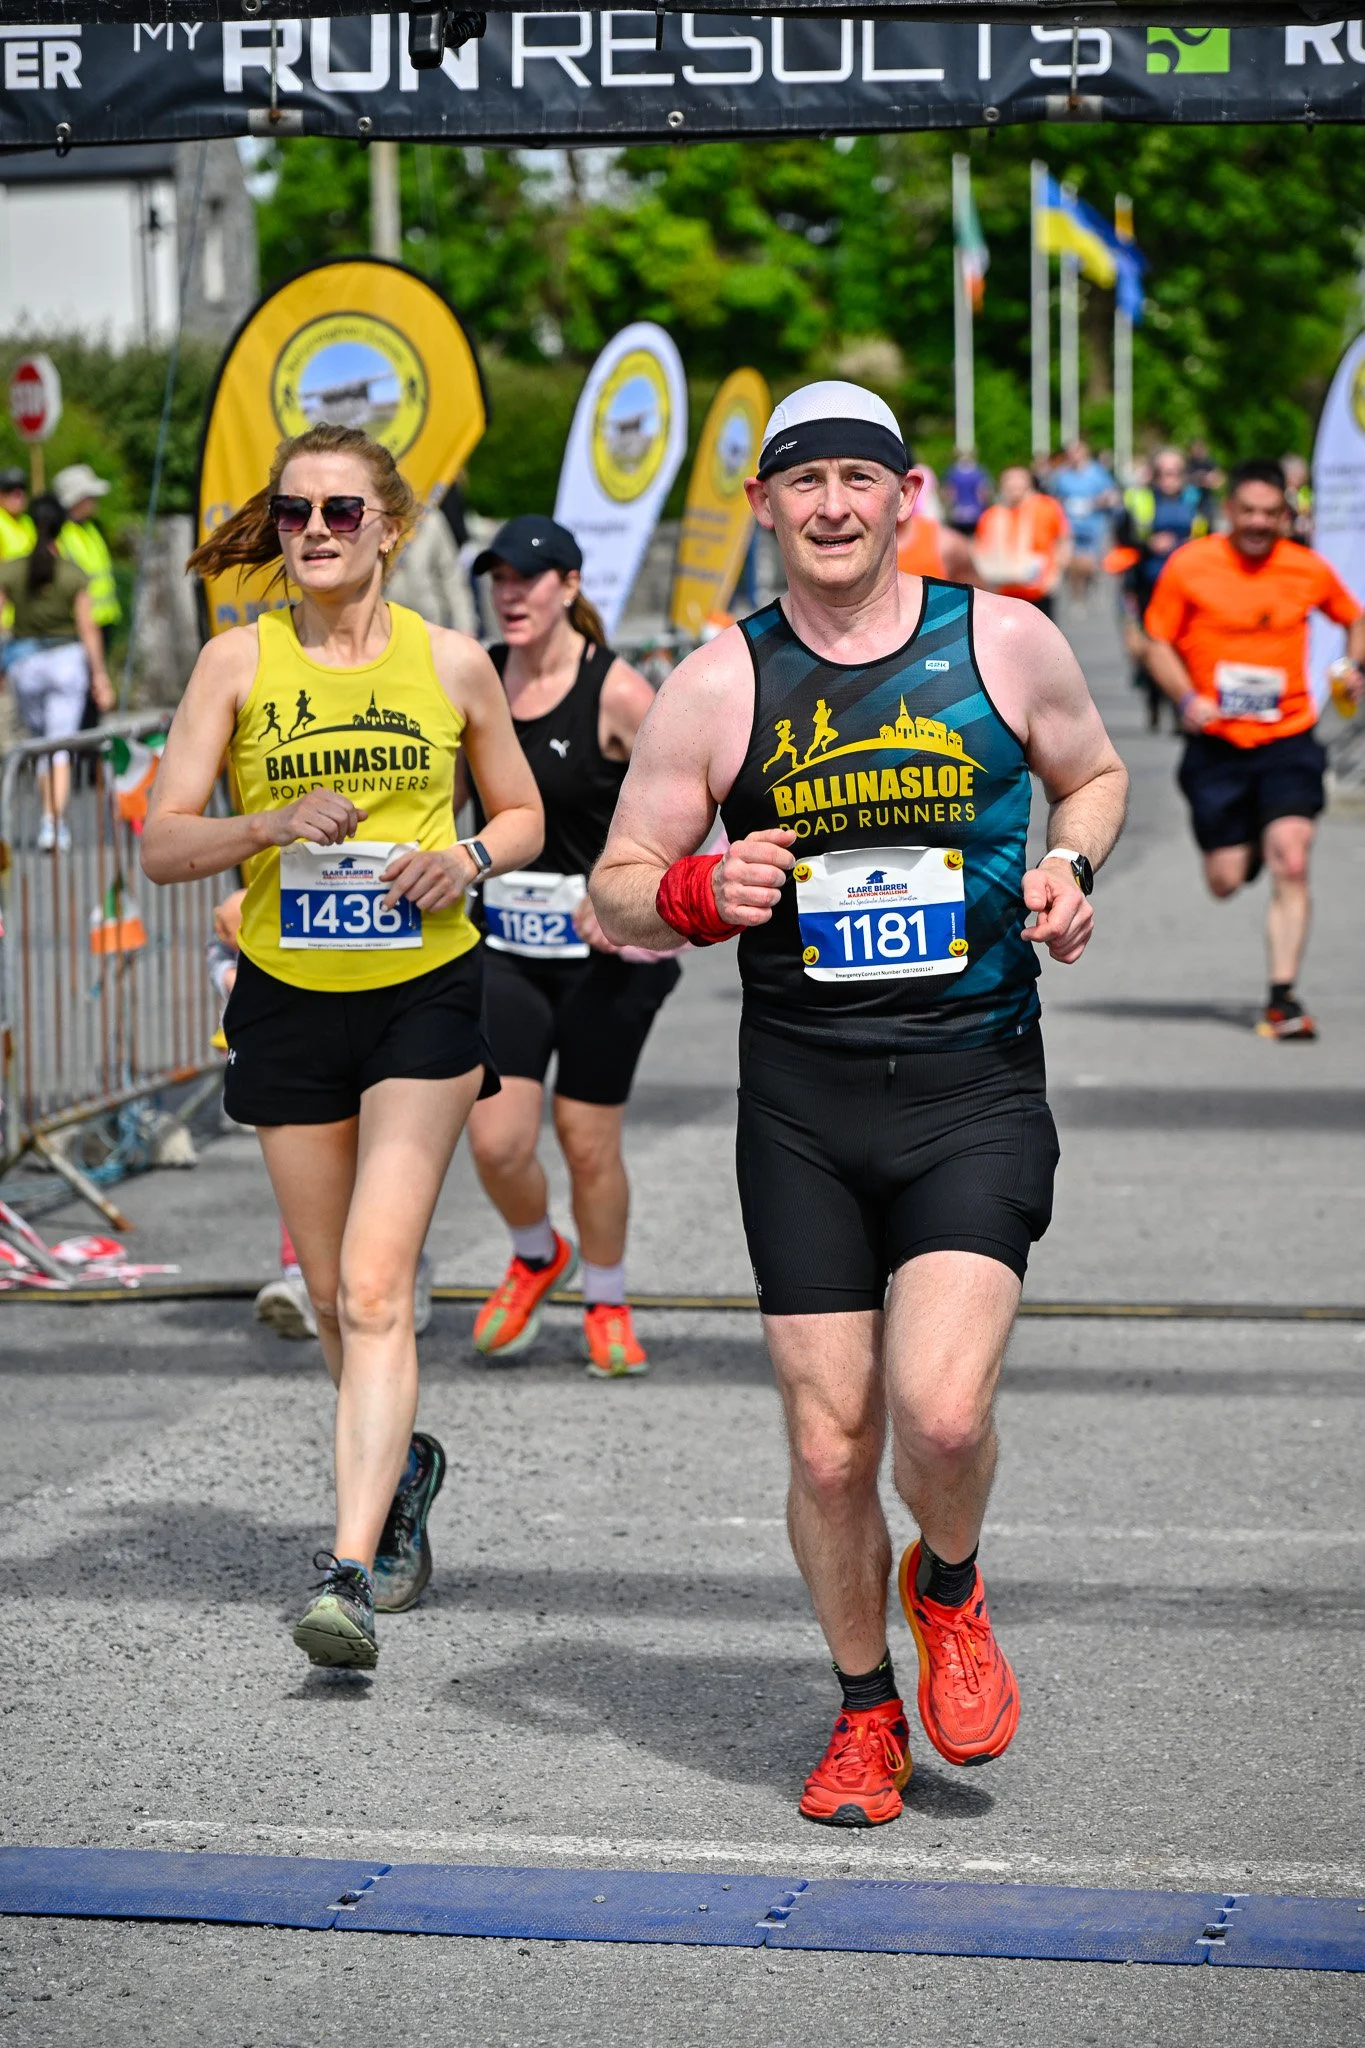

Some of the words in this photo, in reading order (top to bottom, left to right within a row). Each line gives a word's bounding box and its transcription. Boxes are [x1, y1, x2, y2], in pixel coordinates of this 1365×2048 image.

[133, 22, 204, 53] MY
[222, 12, 479, 93] RUN
[266, 745, 431, 781] BALLINASLOE
[333, 776, 430, 793] RUNNERS
[772, 765, 974, 818] BALLINASLOE
[858, 803, 976, 828] RUNNERS
[874, 883, 908, 892] BURREN
[296, 893, 402, 934] 1436
[498, 911, 568, 945] 1182
[834, 909, 928, 962] 1181
